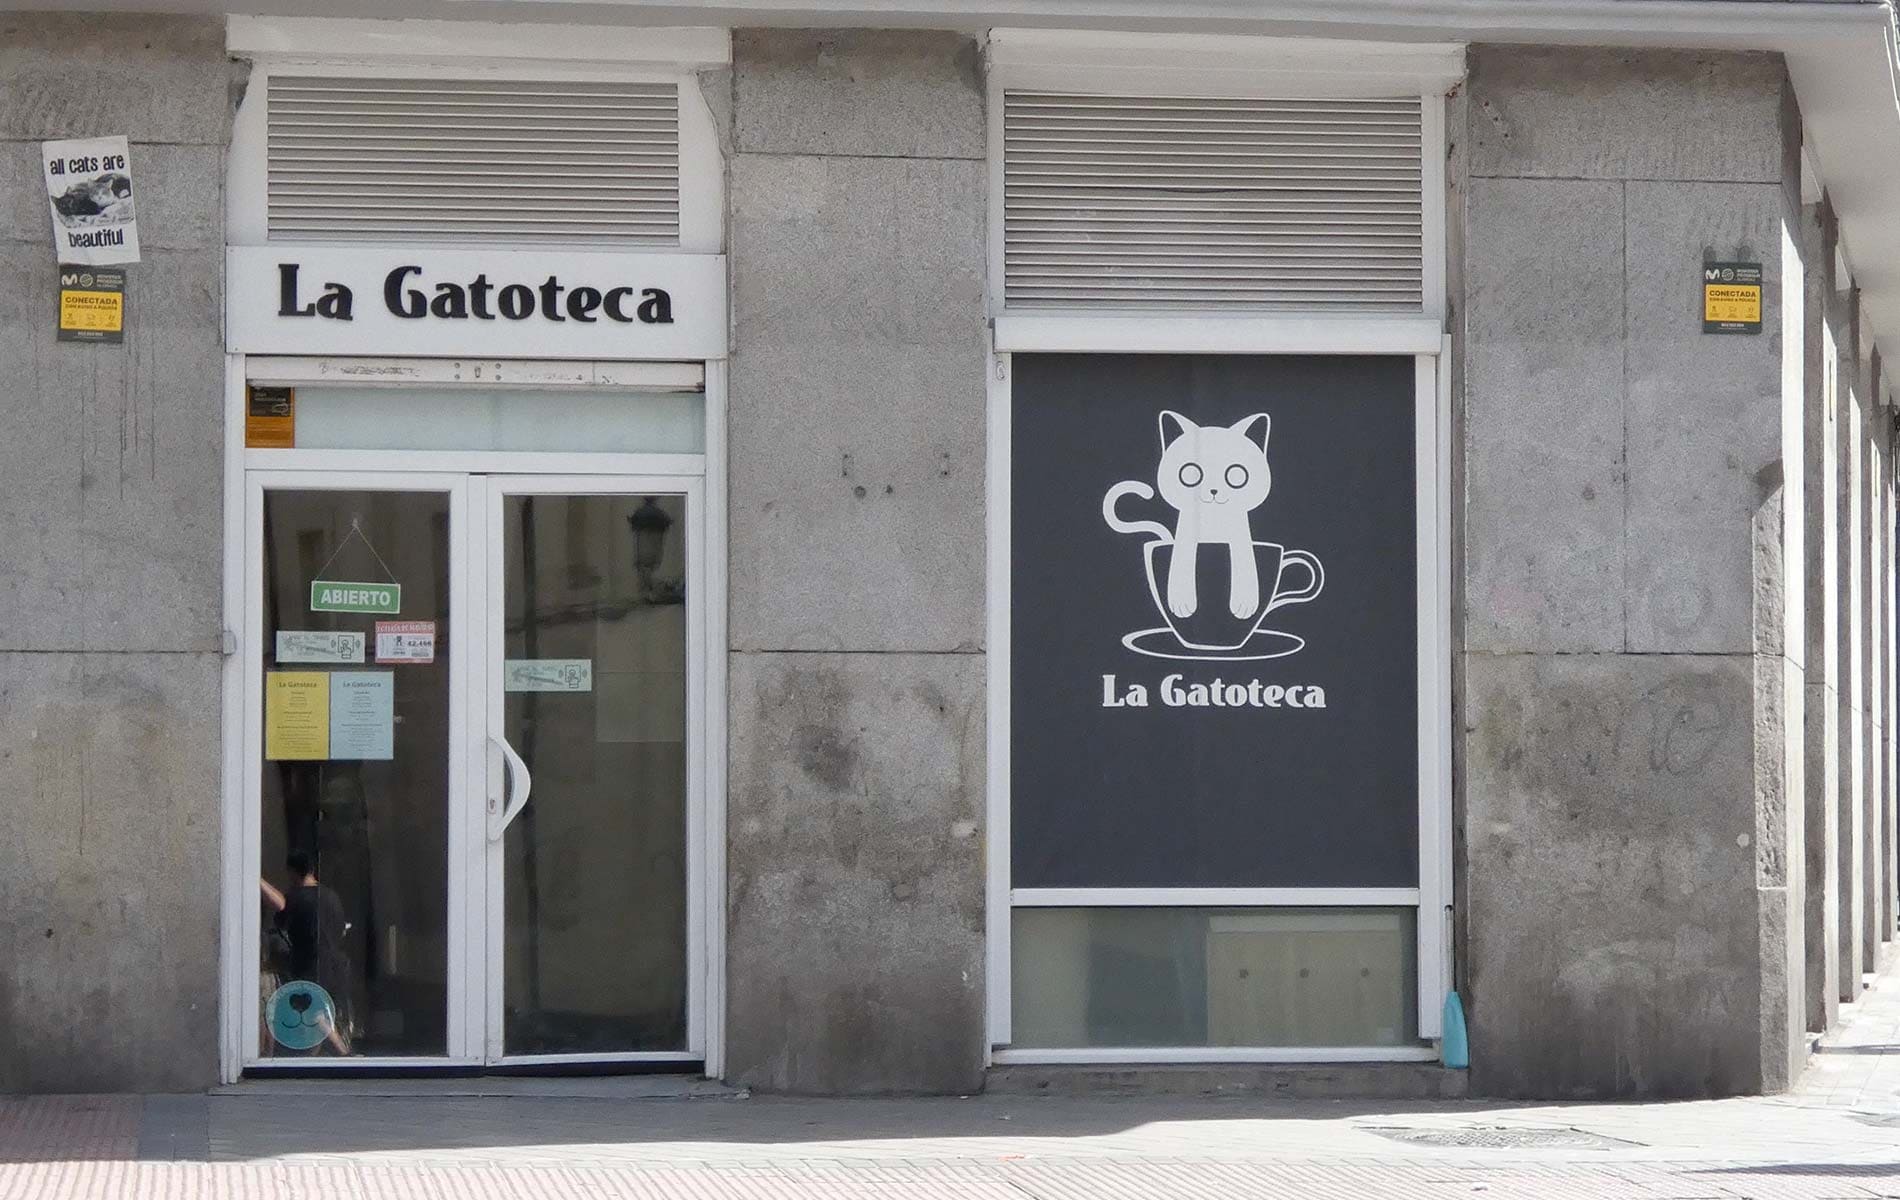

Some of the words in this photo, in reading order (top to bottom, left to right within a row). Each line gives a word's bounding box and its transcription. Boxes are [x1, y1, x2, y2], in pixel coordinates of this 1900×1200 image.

[49, 157, 65, 175] all
[69, 156, 99, 174] cats
[103, 153, 125, 170] are
[67, 228, 124, 248] beautiful
[65, 296, 118, 305] CONECTADA
[278, 263, 354, 321] La
[383, 264, 674, 324] Gatoteca
[1709, 290, 1756, 298] CONECTADA
[320, 589, 391, 606] ABIERTO
[1102, 674, 1148, 707] La
[1160, 674, 1327, 708] Gatoteca
